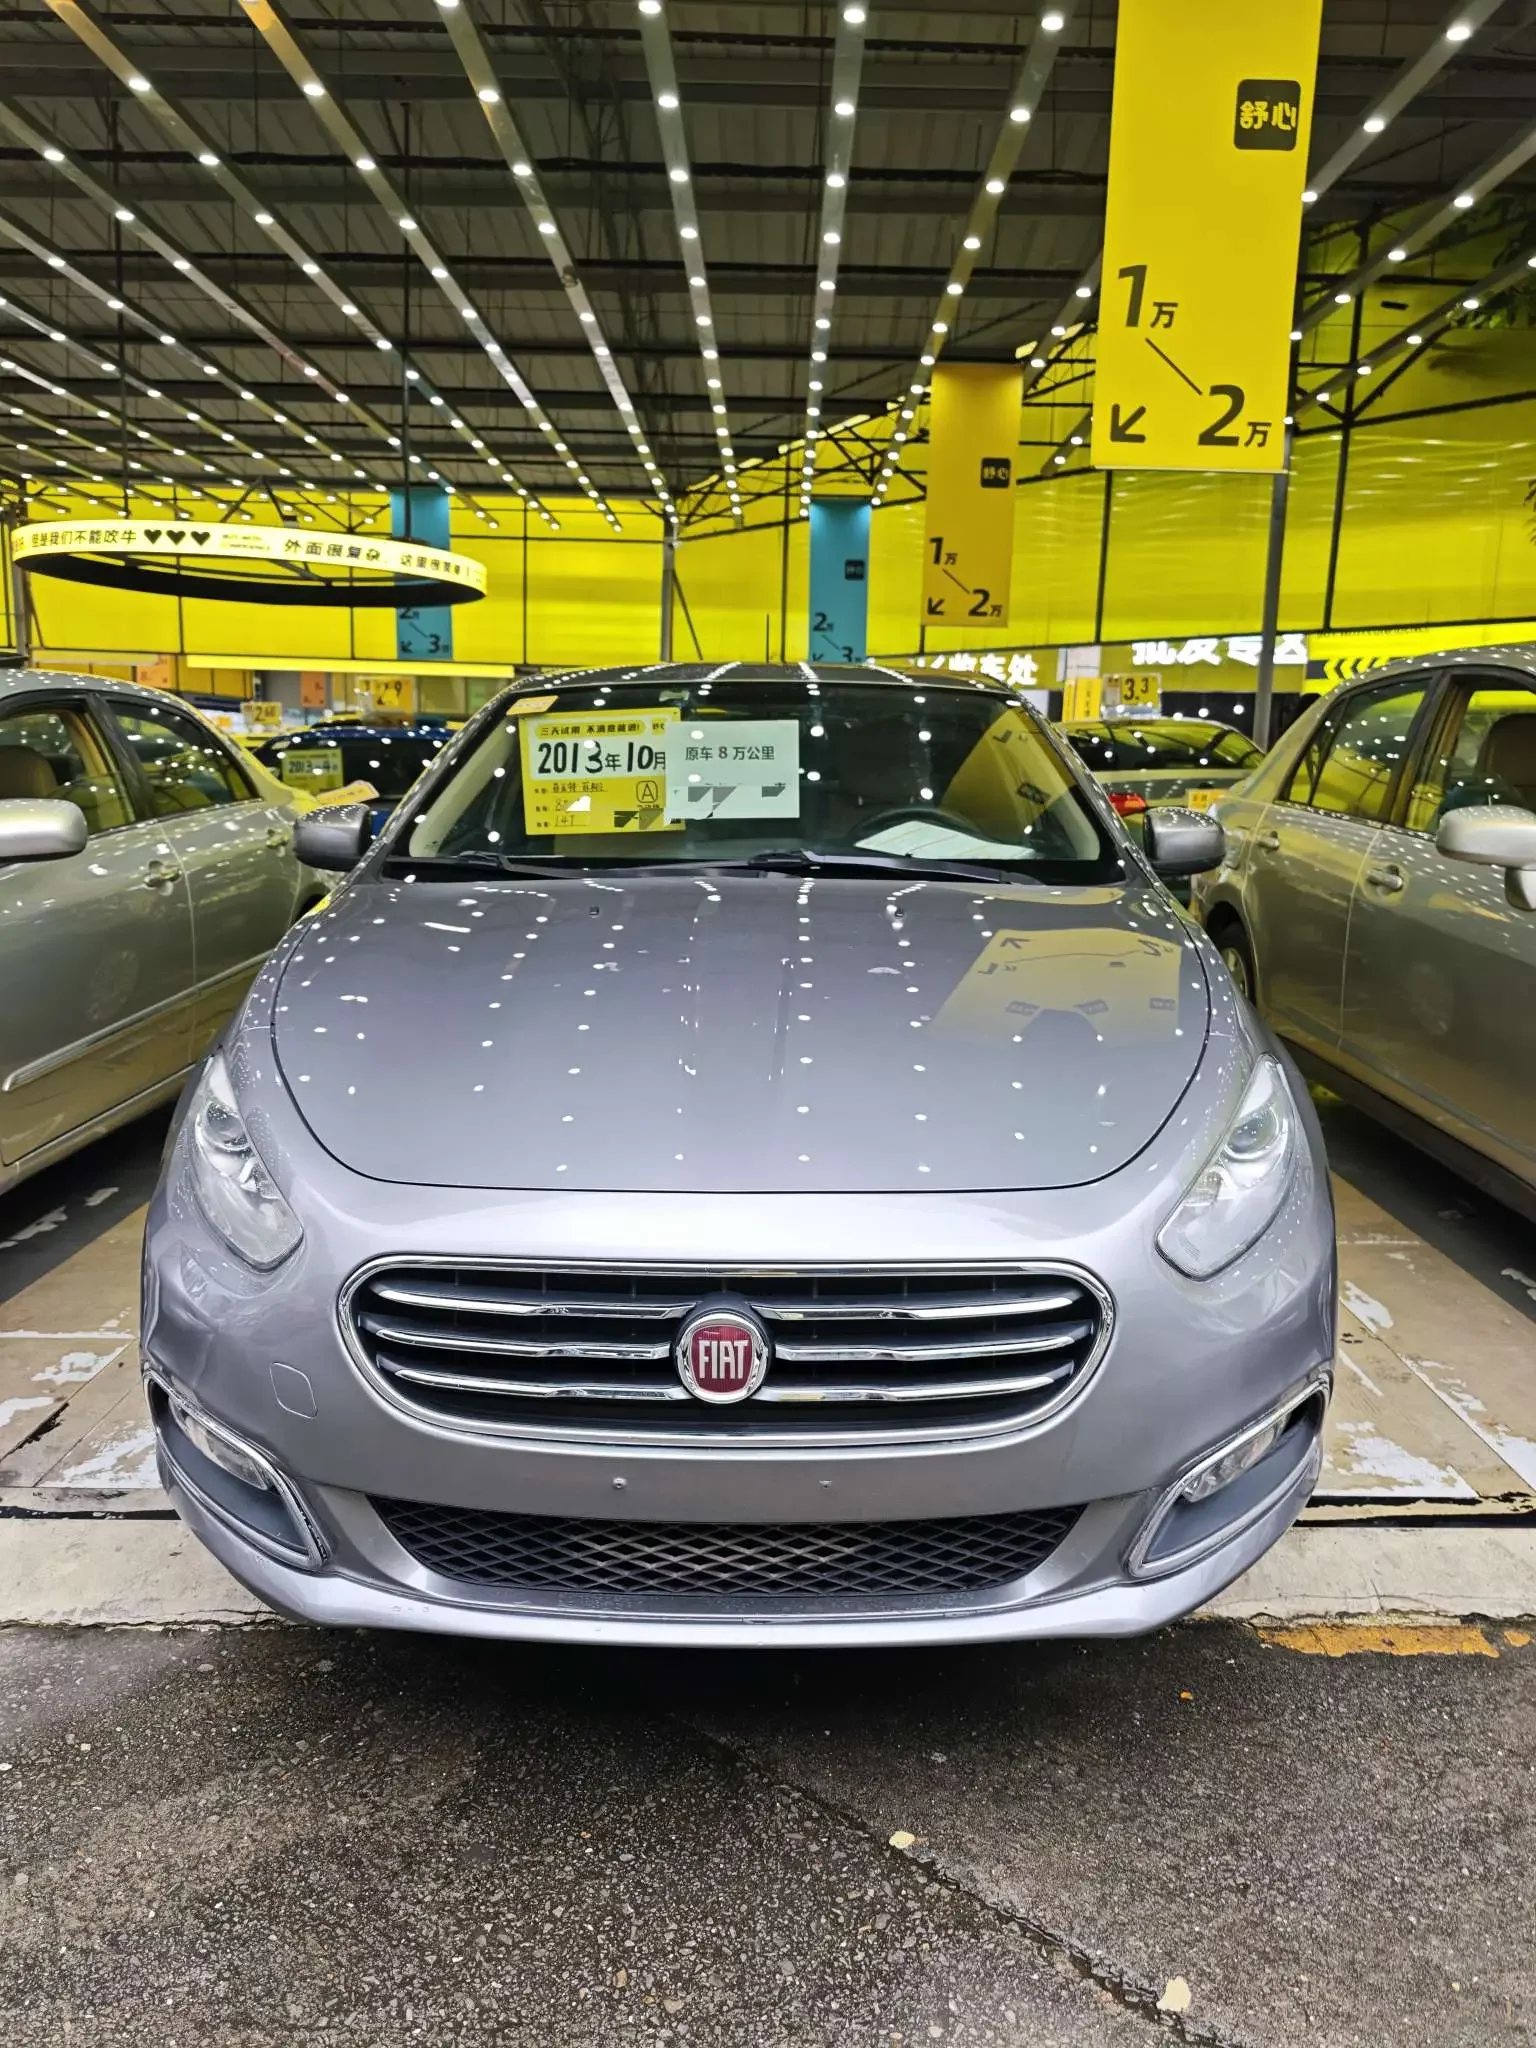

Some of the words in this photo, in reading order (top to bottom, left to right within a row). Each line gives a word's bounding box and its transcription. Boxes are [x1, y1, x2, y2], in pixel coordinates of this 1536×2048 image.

[1239, 100, 1296, 131] 舒心
[1117, 263, 1179, 329] 1万
[1197, 383, 1272, 448] 2万
[929, 537, 958, 565] 1万
[968, 589, 1003, 617] 2万
[686, 746, 713, 760] 原车
[718, 746, 728, 759] 8
[732, 746, 775, 760] 万公里
[698, 1339, 749, 1380] FIAT
